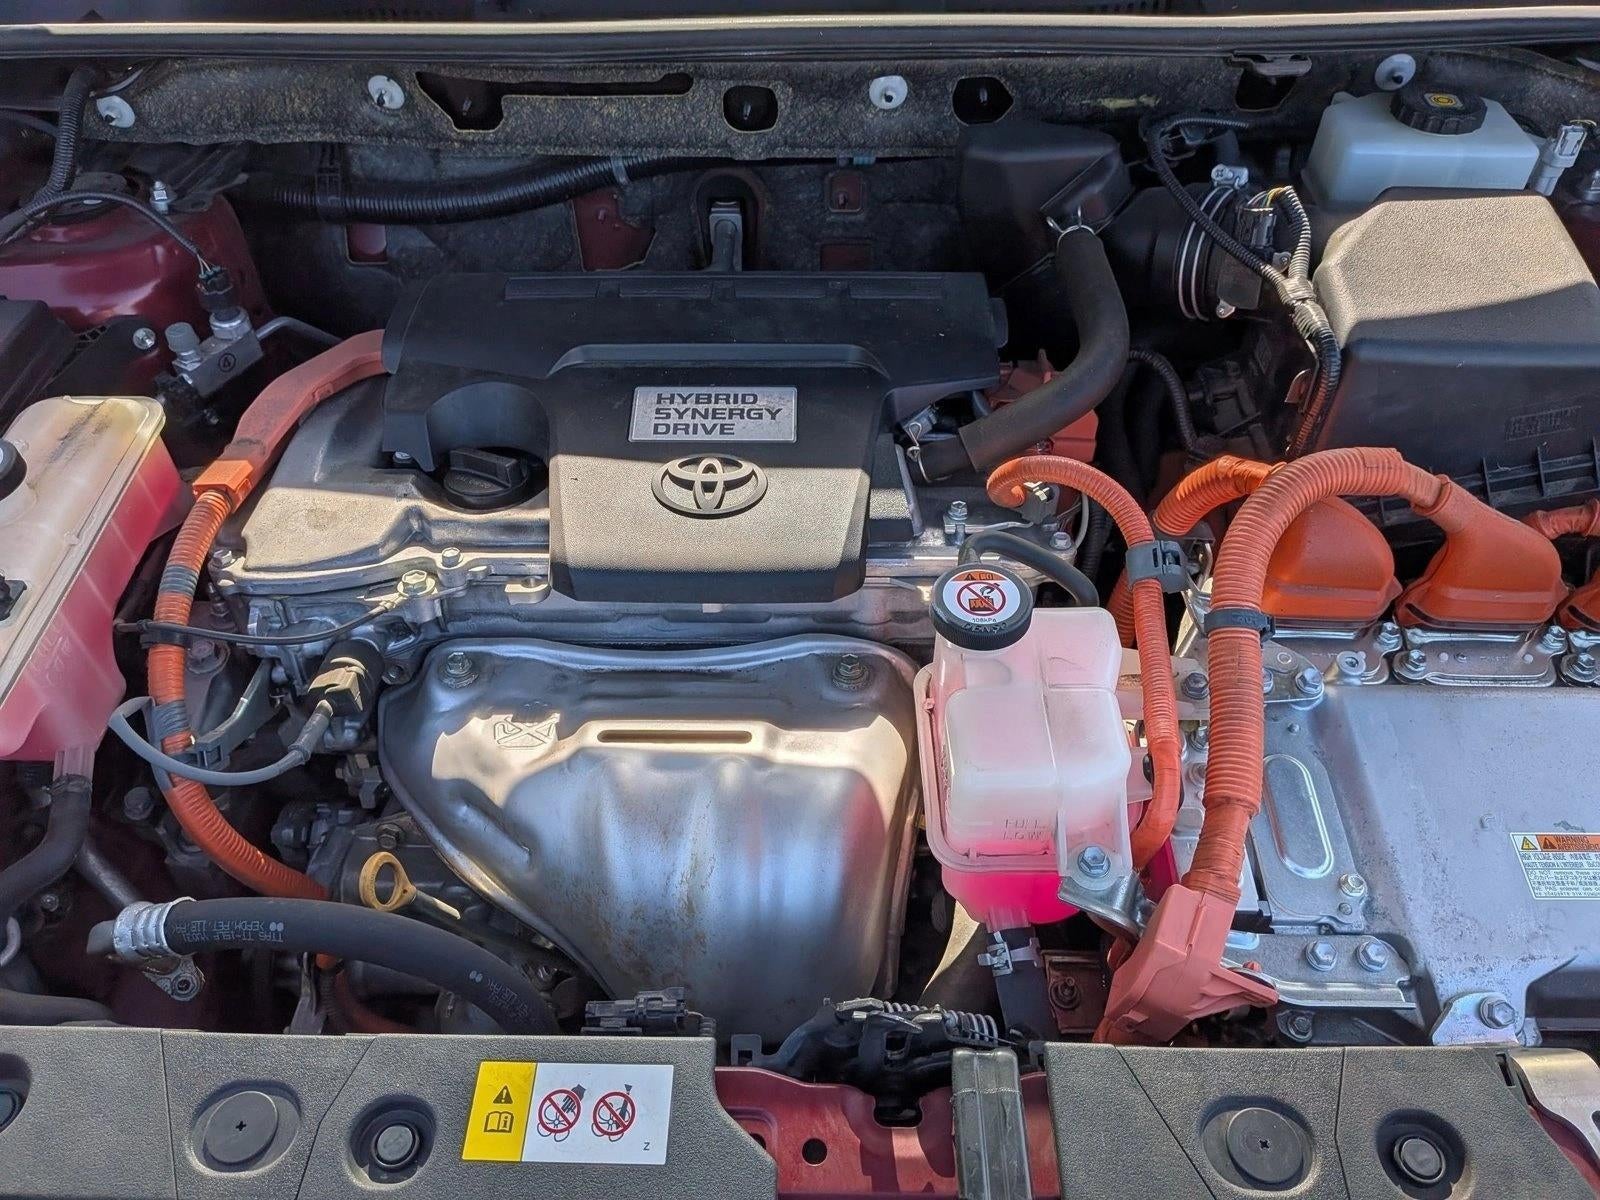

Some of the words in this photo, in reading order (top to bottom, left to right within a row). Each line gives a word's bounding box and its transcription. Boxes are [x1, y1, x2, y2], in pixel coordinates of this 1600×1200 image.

[656, 393, 758, 405] HYBRID
[654, 408, 783, 420] SYNERGY
[652, 423, 736, 436] DRIVE
[643, 1141, 651, 1151] Z
